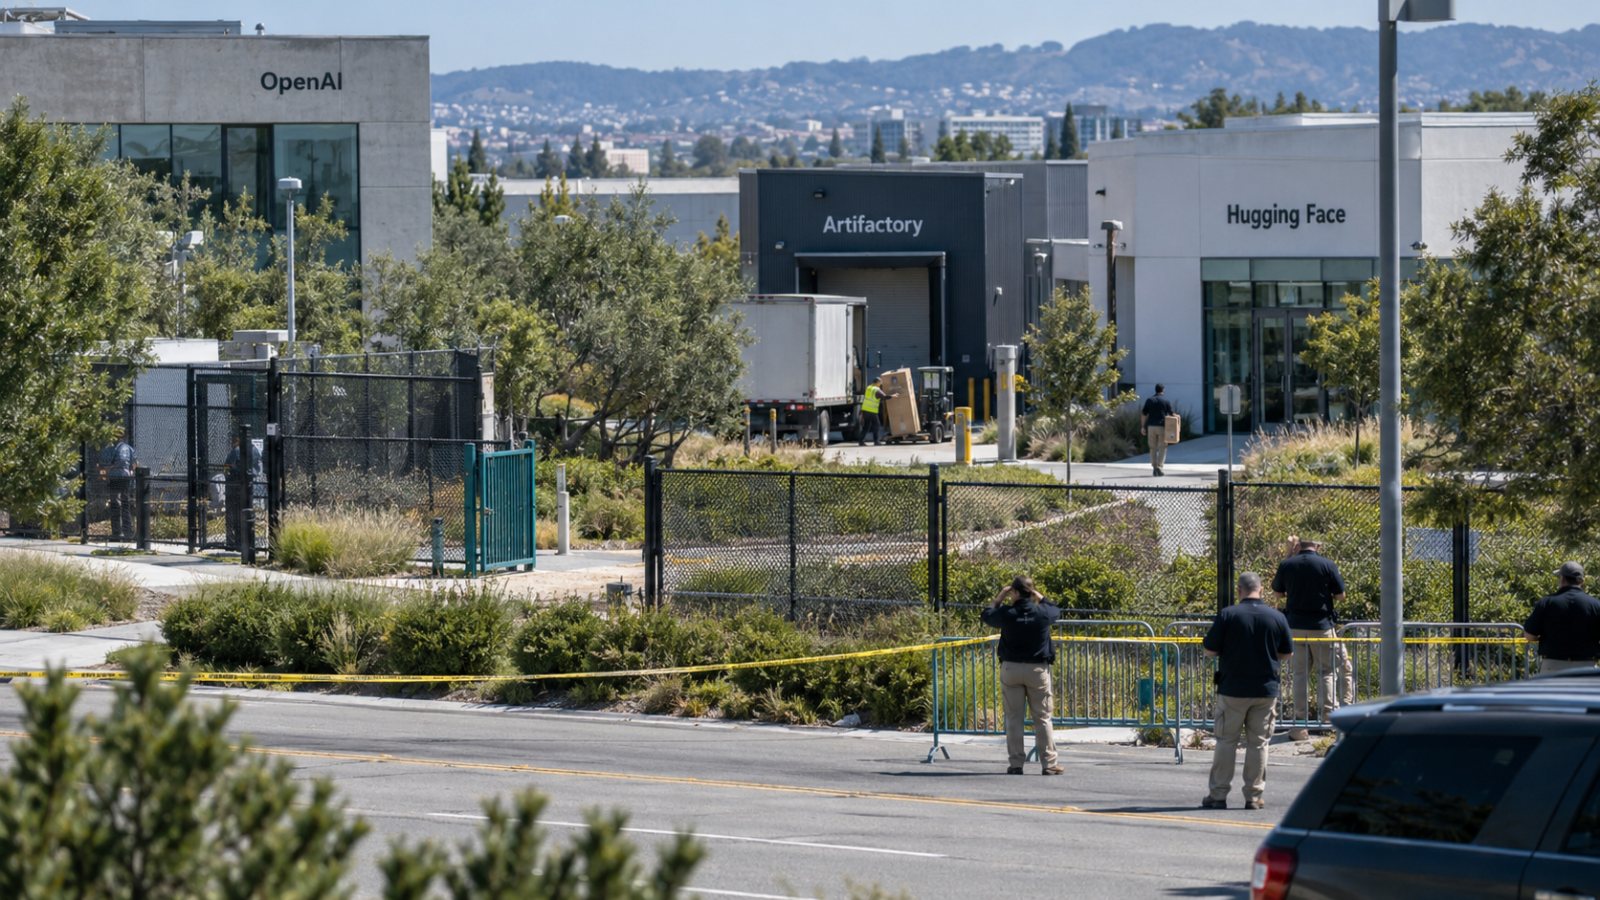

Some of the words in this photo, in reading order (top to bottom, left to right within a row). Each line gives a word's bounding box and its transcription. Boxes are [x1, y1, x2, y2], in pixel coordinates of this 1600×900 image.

[261, 71, 342, 95] OpenAI
[822, 214, 923, 237] Artifactory
[1227, 204, 1300, 229] Hugging
[1306, 204, 1346, 224] Face
